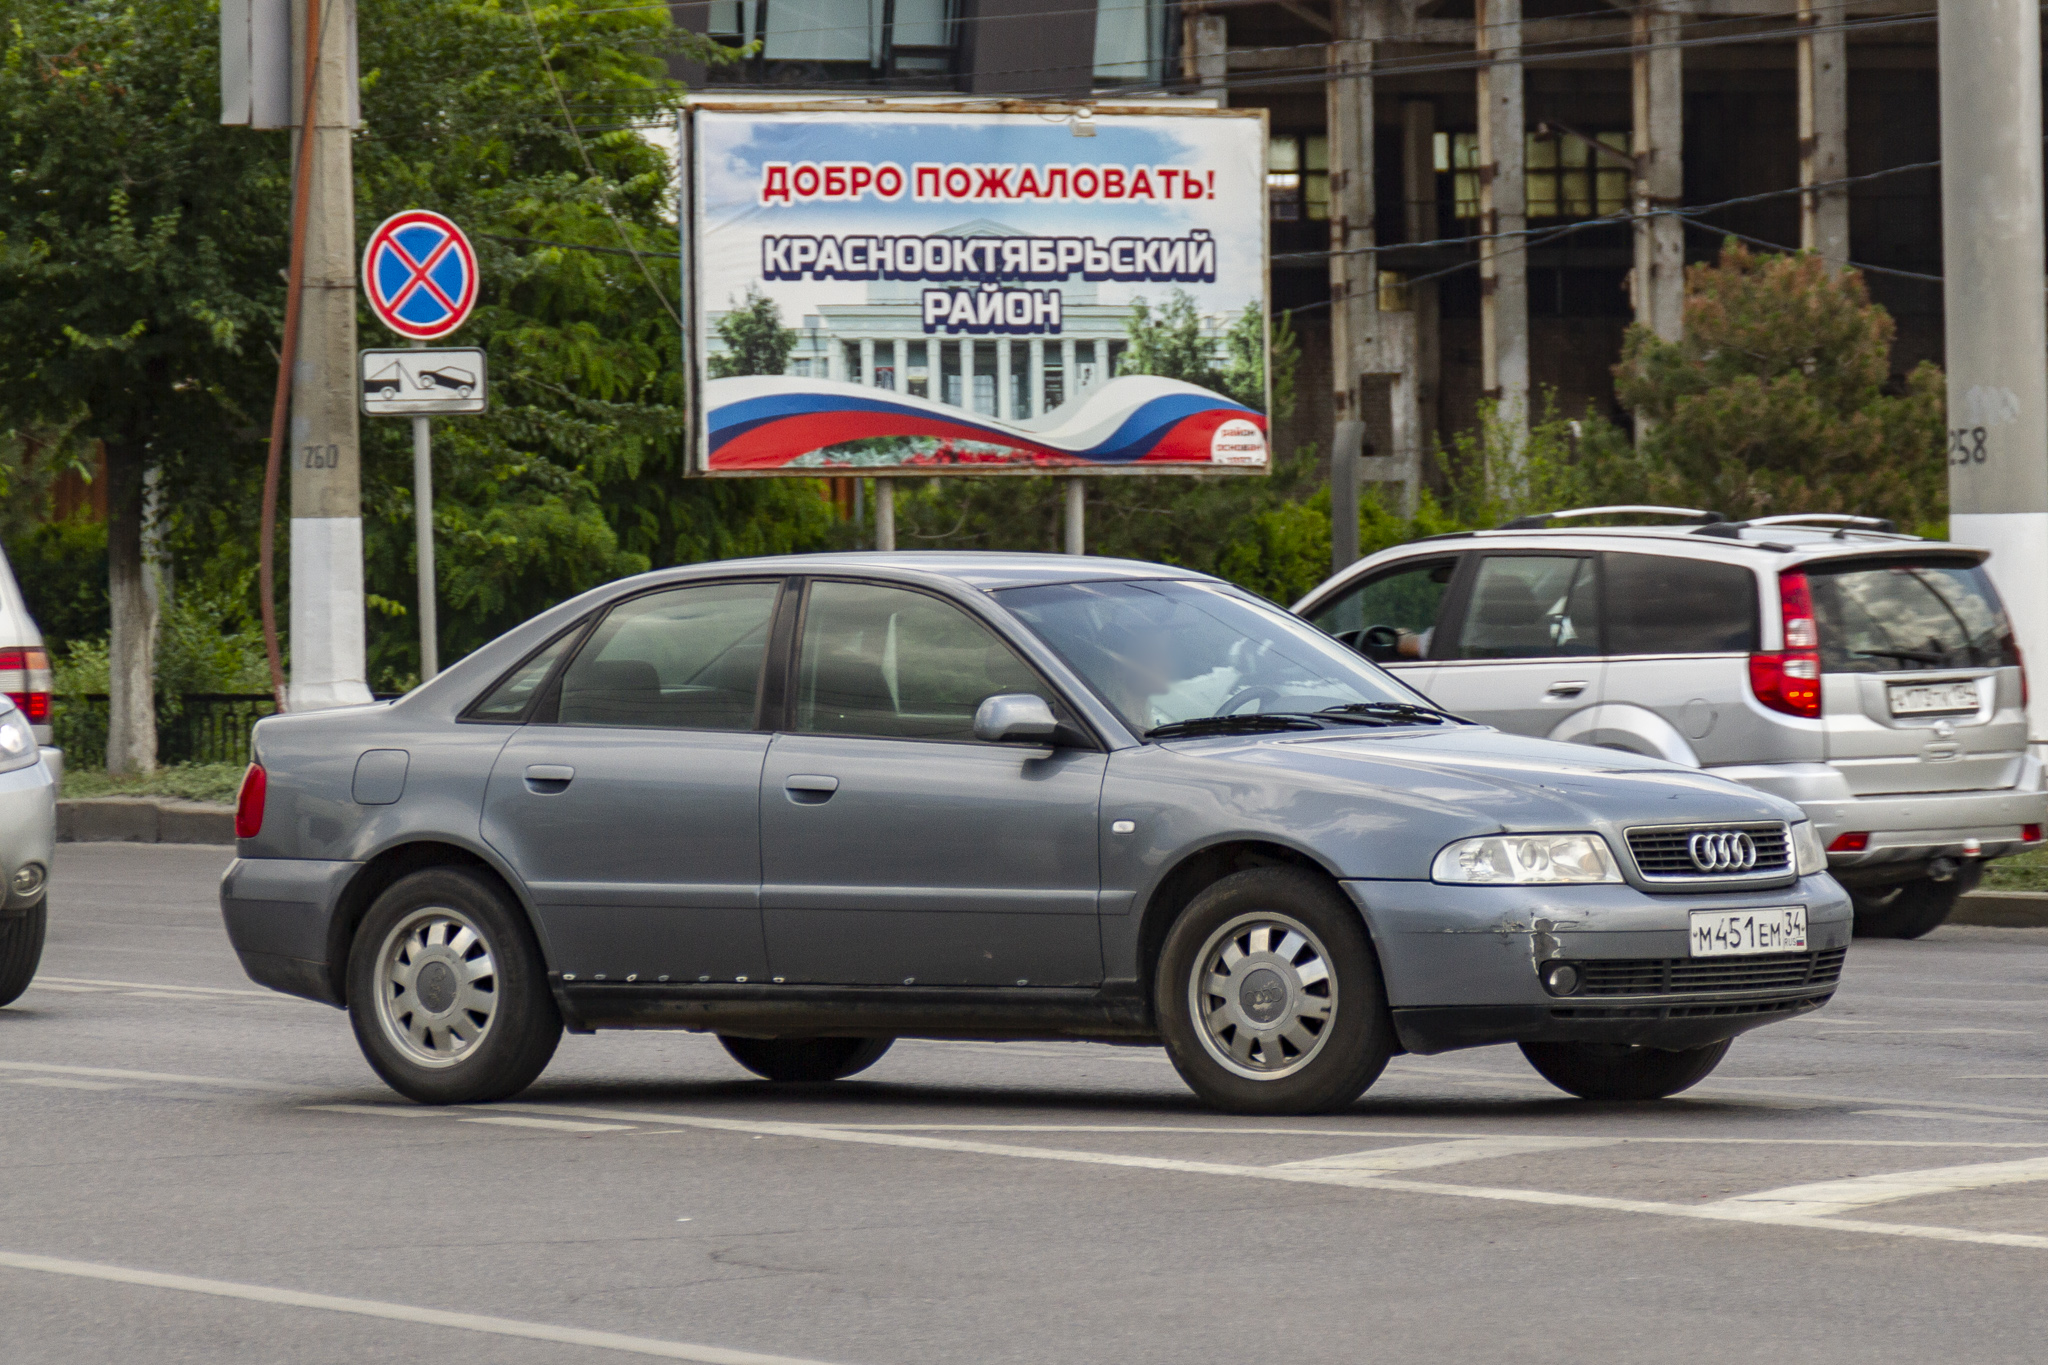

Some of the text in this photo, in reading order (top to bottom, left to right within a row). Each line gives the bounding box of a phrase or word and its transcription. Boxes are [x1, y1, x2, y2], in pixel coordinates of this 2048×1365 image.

[762, 164, 1217, 203] ДОБРО ПОЖАЛОВАТЬ!
[764, 230, 1215, 280] КРАСНООКТЯБРЬСКИЙ
[924, 282, 1062, 331] РАЙОН
[1784, 911, 1802, 937] 34
[1784, 937, 1797, 947] RUS
